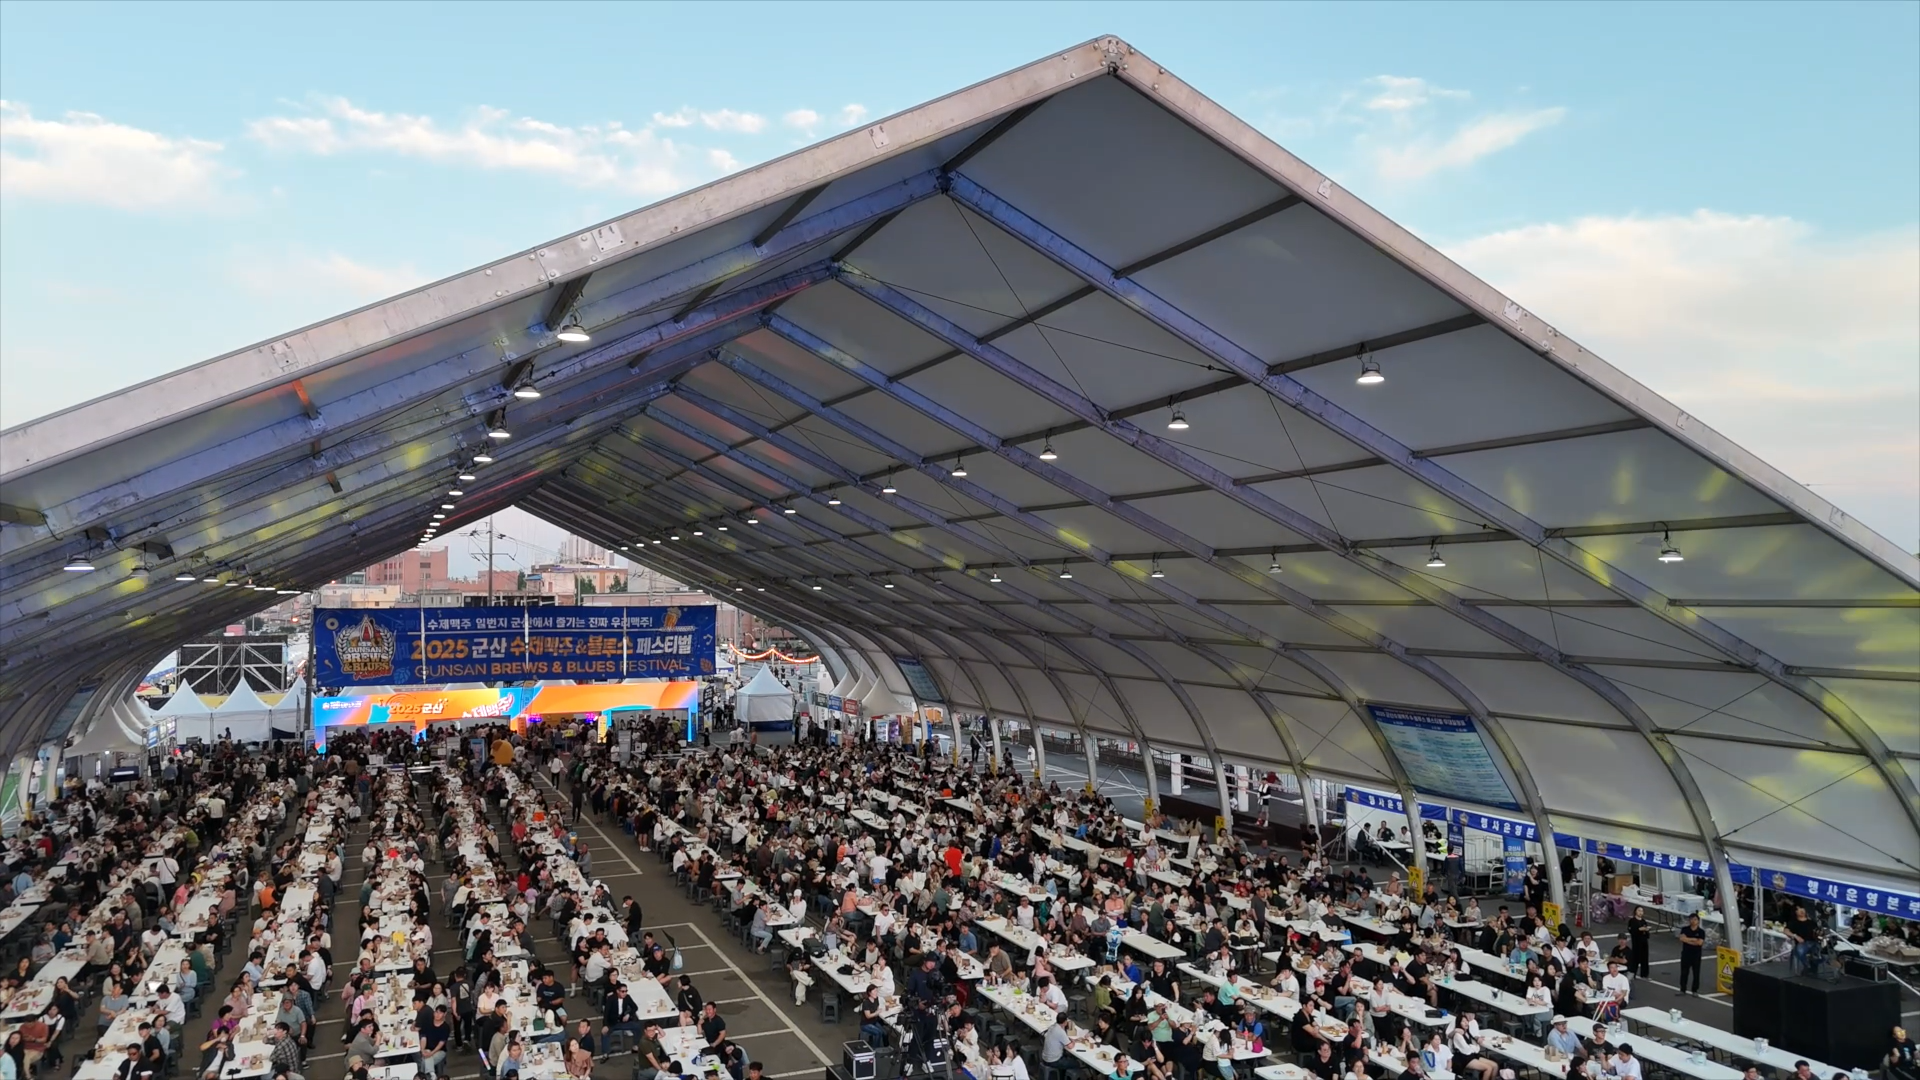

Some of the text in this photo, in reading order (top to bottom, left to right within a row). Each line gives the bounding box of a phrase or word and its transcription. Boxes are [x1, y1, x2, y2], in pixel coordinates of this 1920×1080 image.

[428, 618, 471, 630] 수제맥주
[476, 618, 508, 630] 일번지
[510, 616, 553, 628] 군산에서
[556, 616, 586, 628] 즐기는
[588, 616, 608, 628] 진짜
[411, 638, 468, 660] 2025
[472, 637, 507, 658] 군산
[636, 634, 692, 656] 페스티벌
[343, 653, 388, 662] BREWS
[415, 663, 487, 678] GUNSAN
[491, 661, 548, 675] BREWS
[552, 661, 562, 673] &
[566, 660, 616, 673] BLUES
